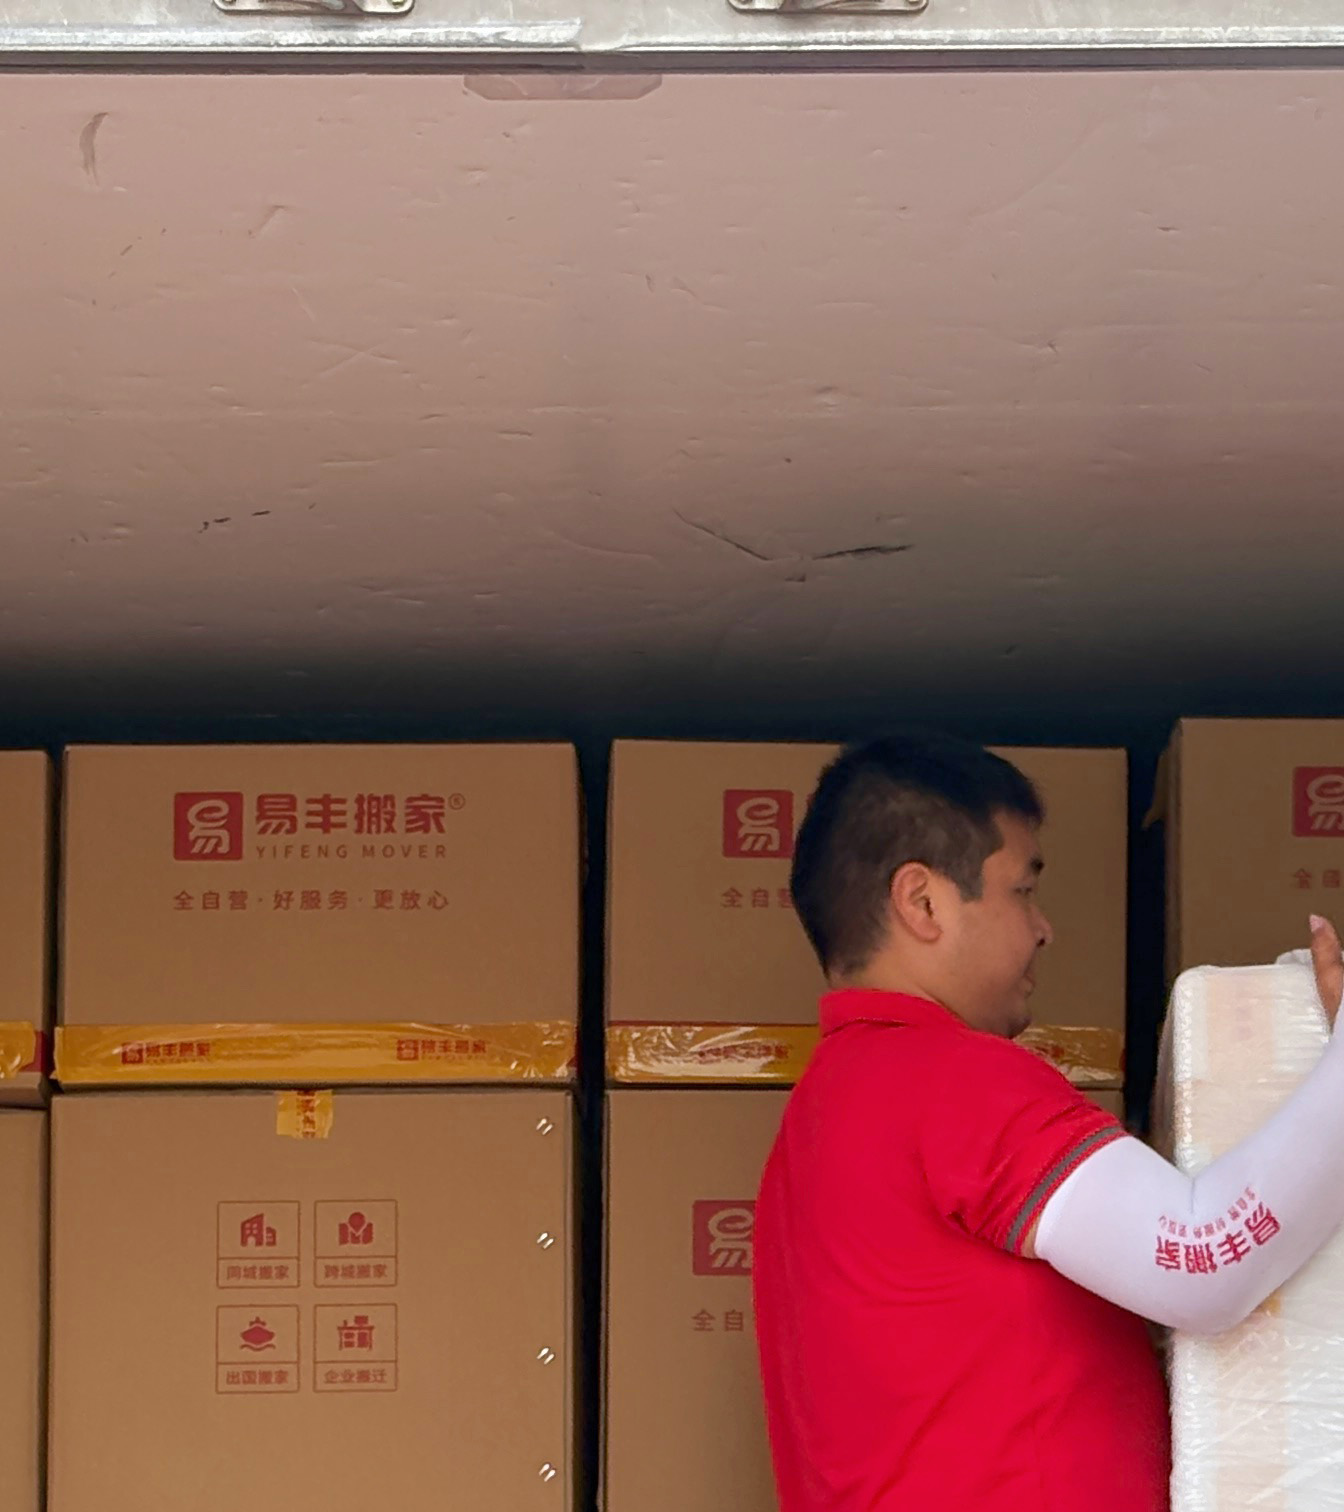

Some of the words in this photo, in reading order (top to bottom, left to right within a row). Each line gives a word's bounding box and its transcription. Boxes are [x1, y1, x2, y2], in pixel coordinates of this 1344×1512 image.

[256, 844, 348, 859] YIFENG
[362, 844, 448, 859] MOVER
[1156, 1202, 1281, 1274] 易丰搬家
